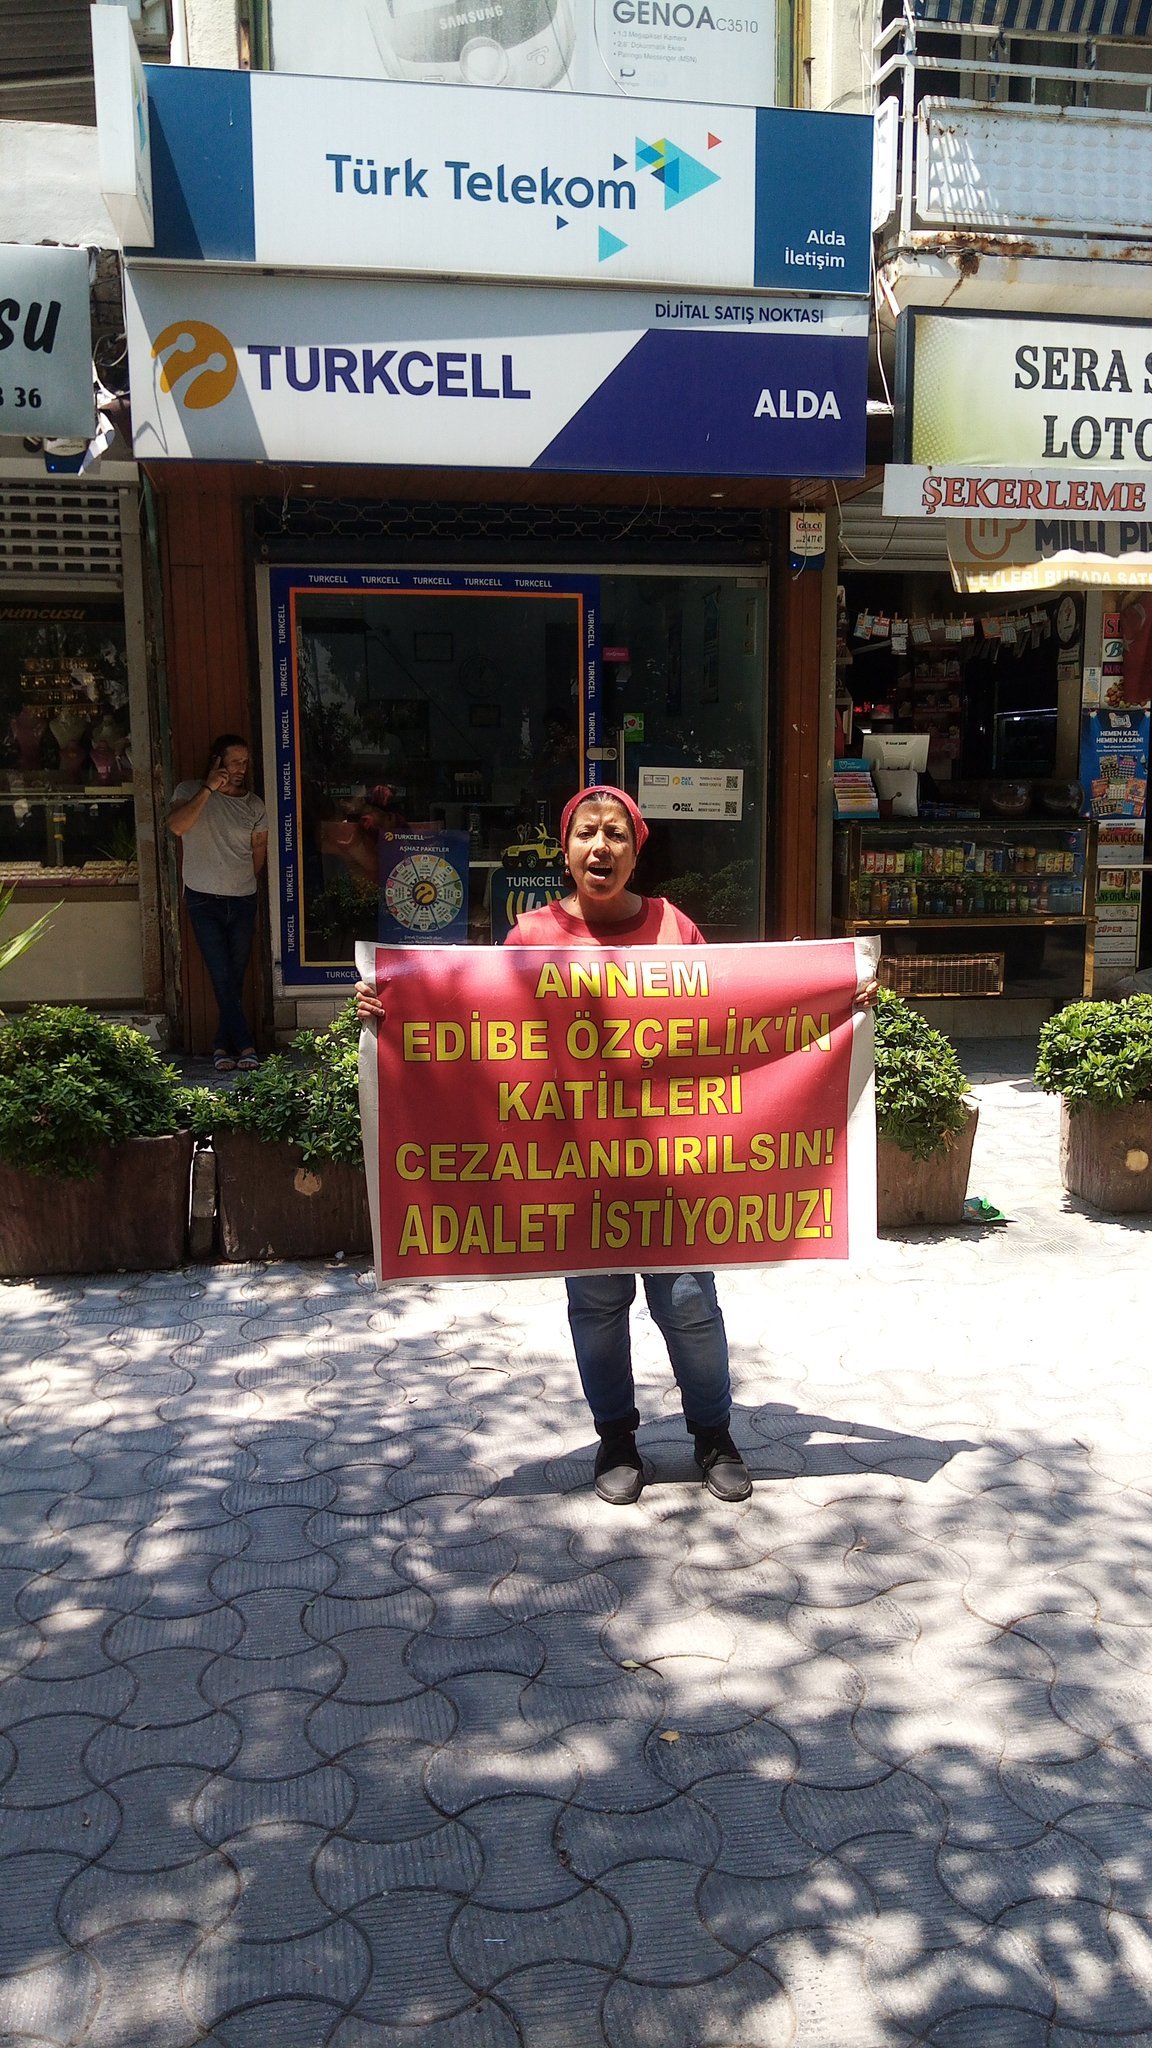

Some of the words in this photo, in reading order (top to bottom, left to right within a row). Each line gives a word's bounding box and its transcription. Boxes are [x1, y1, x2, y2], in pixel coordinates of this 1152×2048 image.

[439, 5, 503, 30] SAMSUNG
[613, 0, 715, 29] GENOA
[716, 18, 758, 33] C3510
[326, 153, 429, 198] Türk
[444, 160, 636, 210] Telekom
[806, 230, 846, 246] Alda
[785, 247, 845, 270] İletişim
[655, 300, 709, 319] DİJİTAL
[714, 305, 754, 324] SATIŞ
[759, 307, 824, 323] NOKTASI
[247, 344, 532, 400] TURKCELL
[1014, 344, 1132, 393] SERA
[14, 387, 42, 408] 36
[753, 389, 842, 420] ALDA
[1042, 415, 1152, 462] LOTO
[921, 476, 1147, 515] ŞEKERLEME
[308, 575, 348, 584] TURKCELL
[361, 576, 400, 584] TURKCELL
[413, 577, 451, 585] TURKCELL
[464, 578, 502, 587] TURKCELL
[514, 579, 552, 588] TURKCELL
[1044, 568, 1112, 586] BURADA
[278, 603, 286, 644] TURKCELL
[587, 609, 595, 648] TURKCELL
[506, 876, 564, 887] TURKCELL
[1097, 925, 1123, 933] SÜPER
[326, 971, 361, 979] TURKCEL
[535, 961, 709, 999] ANNEM
[403, 1011, 549, 1062] EDİBE
[566, 1007, 831, 1069] ÖZÇELİK'İN
[499, 1066, 743, 1122] KATİLLERİ
[396, 1128, 835, 1182] CEZALANDIRILSIN!
[398, 1201, 575, 1256] ADALET
[590, 1187, 833, 1249] İSTİYORUZ!
